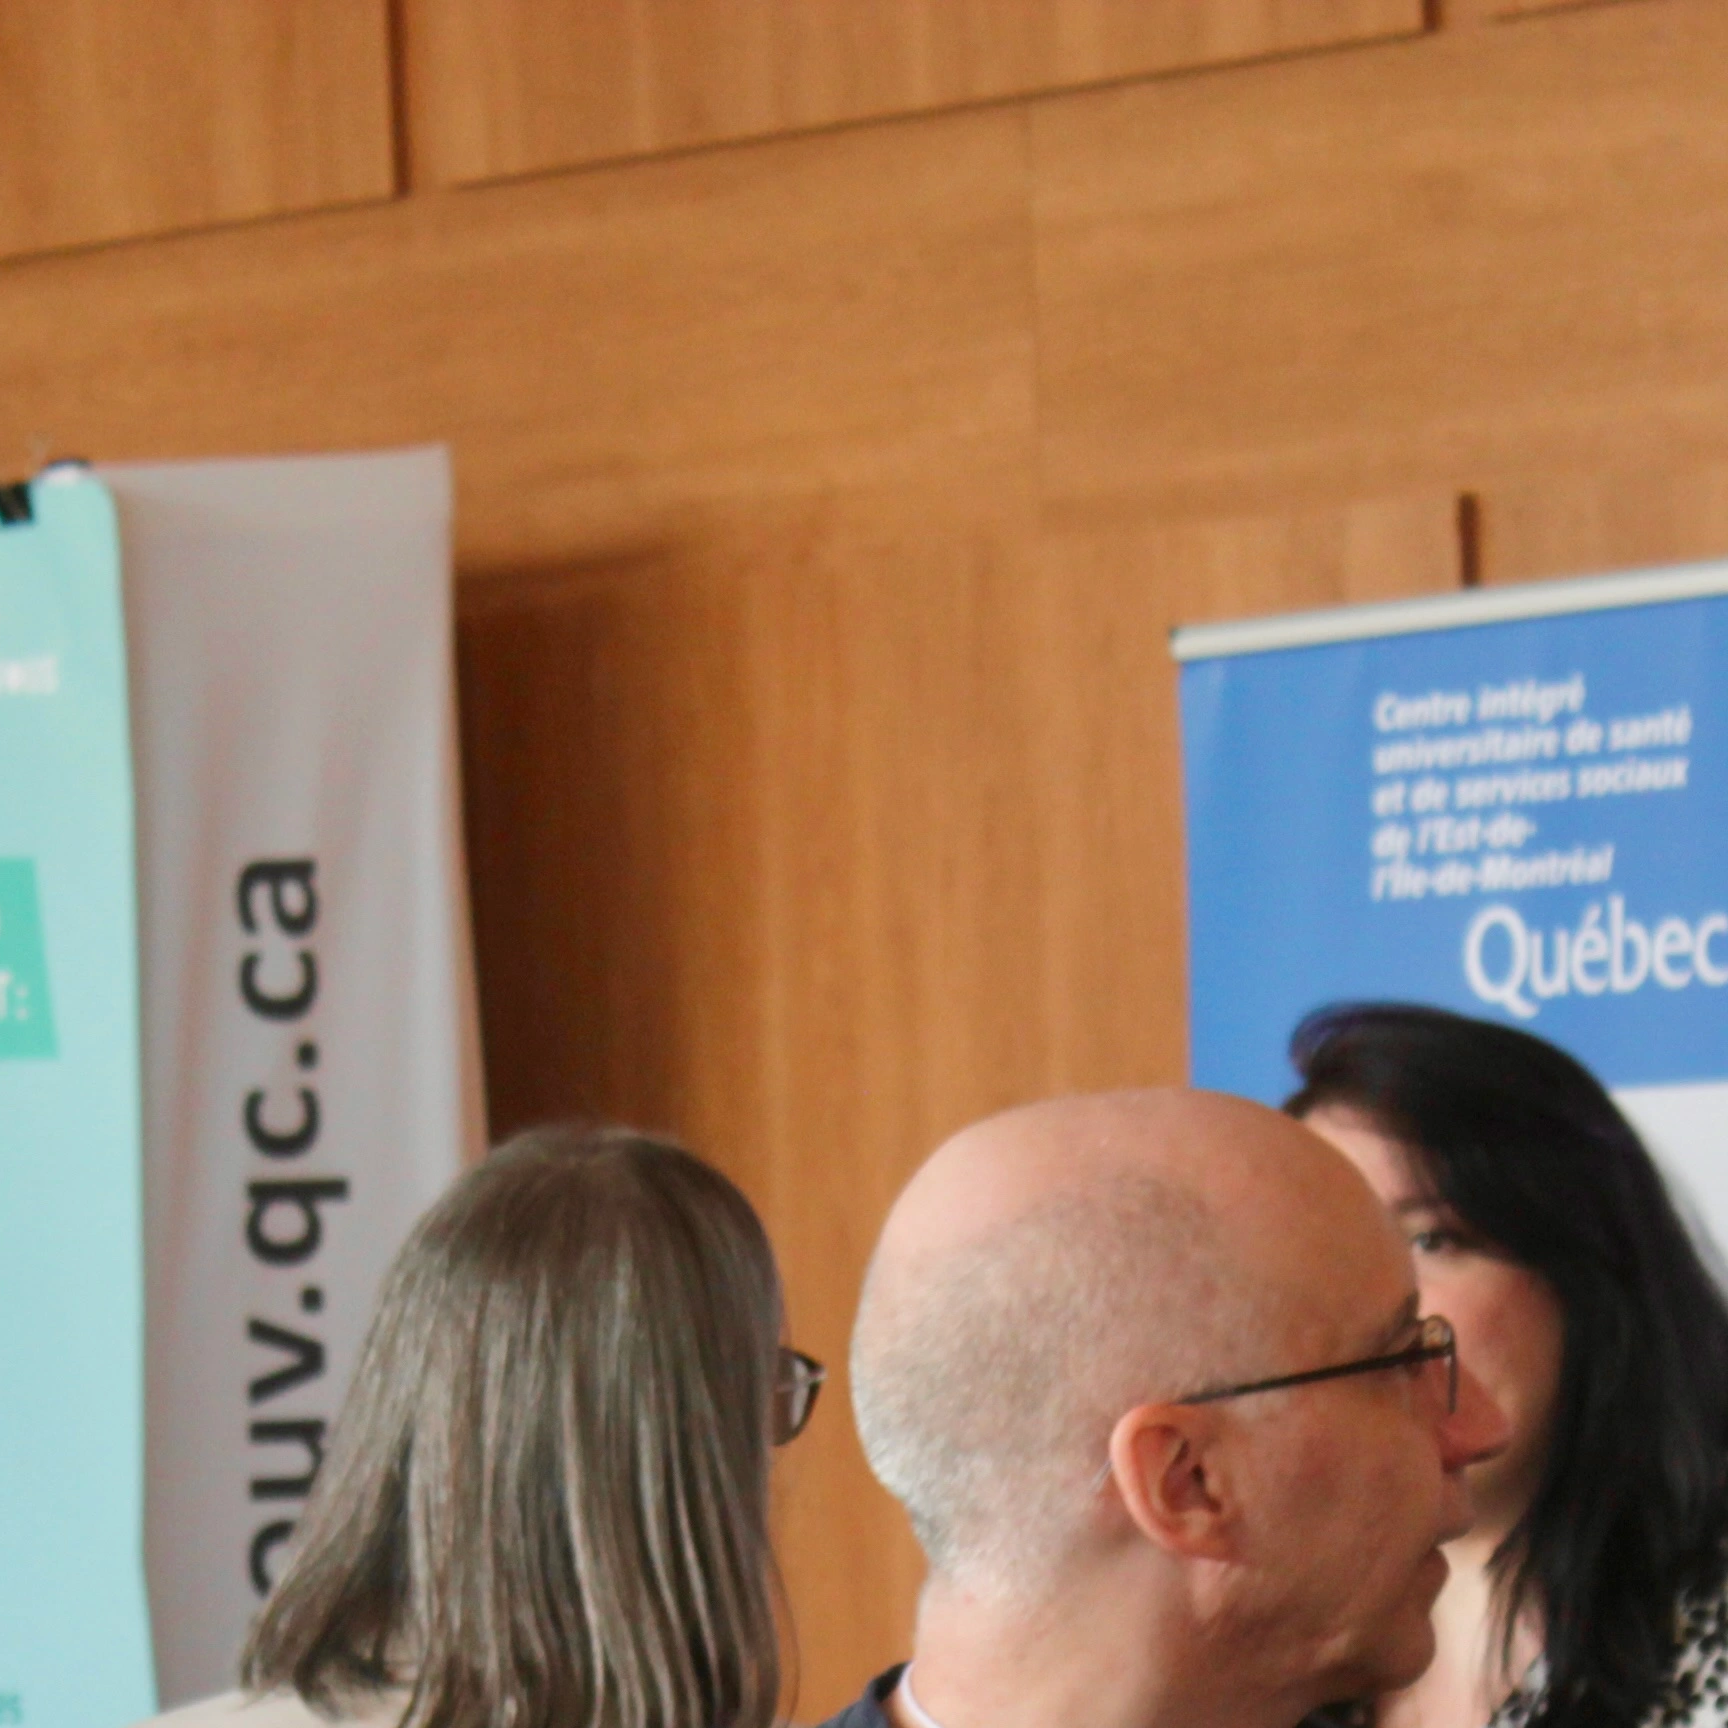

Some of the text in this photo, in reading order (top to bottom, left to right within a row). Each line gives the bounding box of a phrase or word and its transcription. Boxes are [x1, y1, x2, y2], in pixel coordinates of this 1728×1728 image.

[1374, 672, 1586, 732] Centre intégré
[1373, 704, 1693, 774] universitaire de santé
[1373, 757, 1689, 816] et de services sociaux
[1372, 821, 1410, 858] de
